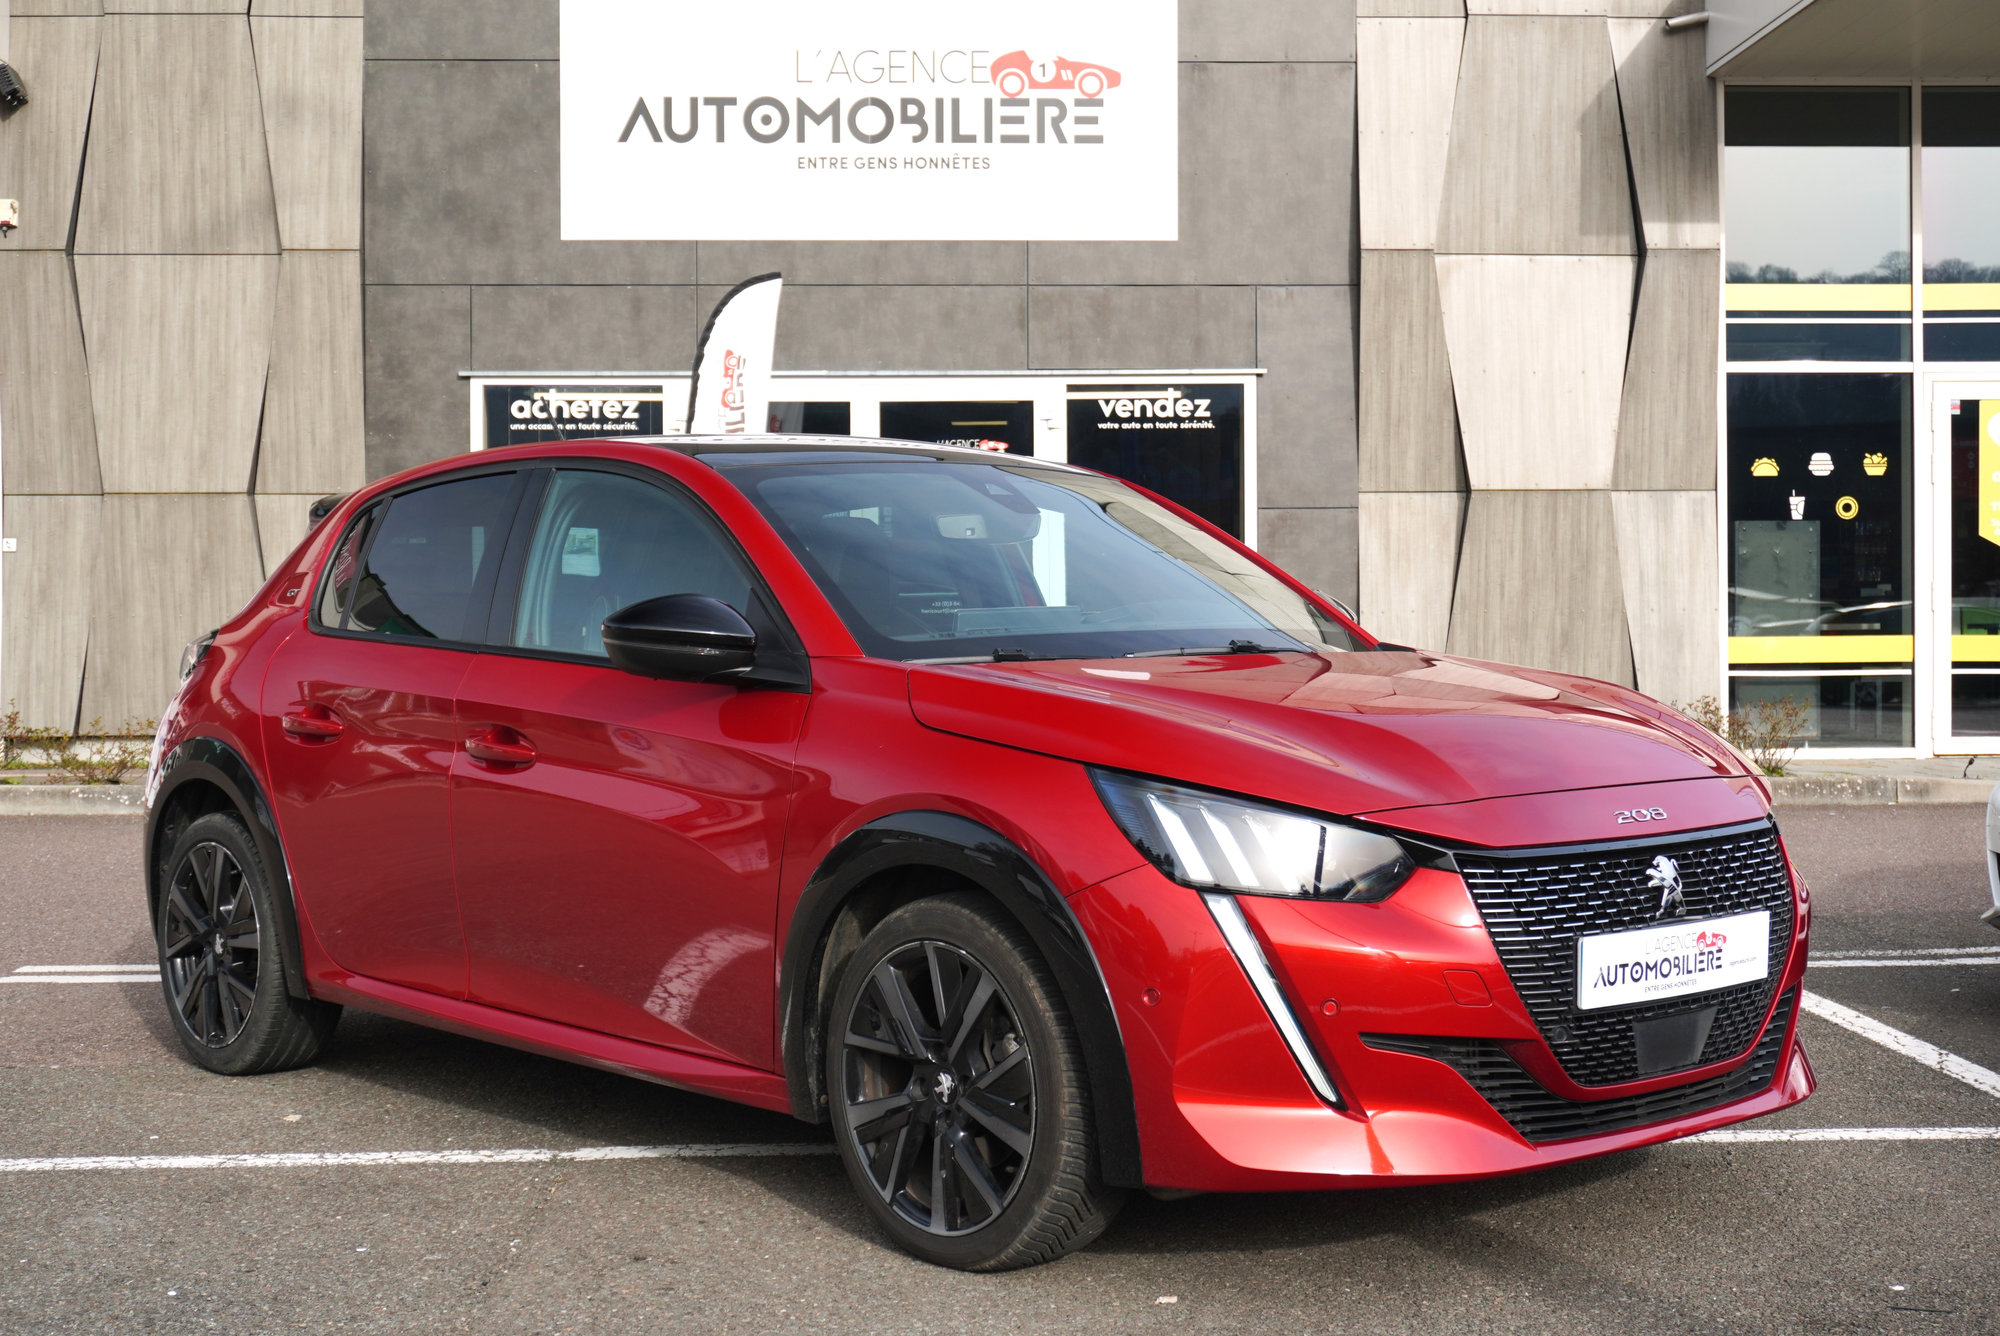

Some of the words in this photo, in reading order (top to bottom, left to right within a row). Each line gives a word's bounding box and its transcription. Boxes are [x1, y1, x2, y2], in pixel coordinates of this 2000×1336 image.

[796, 50, 990, 83] L'AGENCE
[797, 156, 848, 169] ENTRE
[854, 156, 897, 169] GENS
[903, 152, 991, 170] HONNÊTES
[510, 389, 640, 419] achetez
[1097, 388, 1212, 418] vendez
[510, 423, 527, 431] une
[527, 423, 564, 431] occasin
[565, 423, 577, 431] en
[578, 422, 602, 431] toute
[602, 420, 639, 431] sécurité.
[1097, 421, 1120, 430] votre
[1121, 421, 1141, 430] auto
[1142, 422, 1154, 430] en
[1155, 421, 1179, 430] toute
[1180, 419, 1216, 430] sérénité.
[1613, 807, 1667, 824] 208
